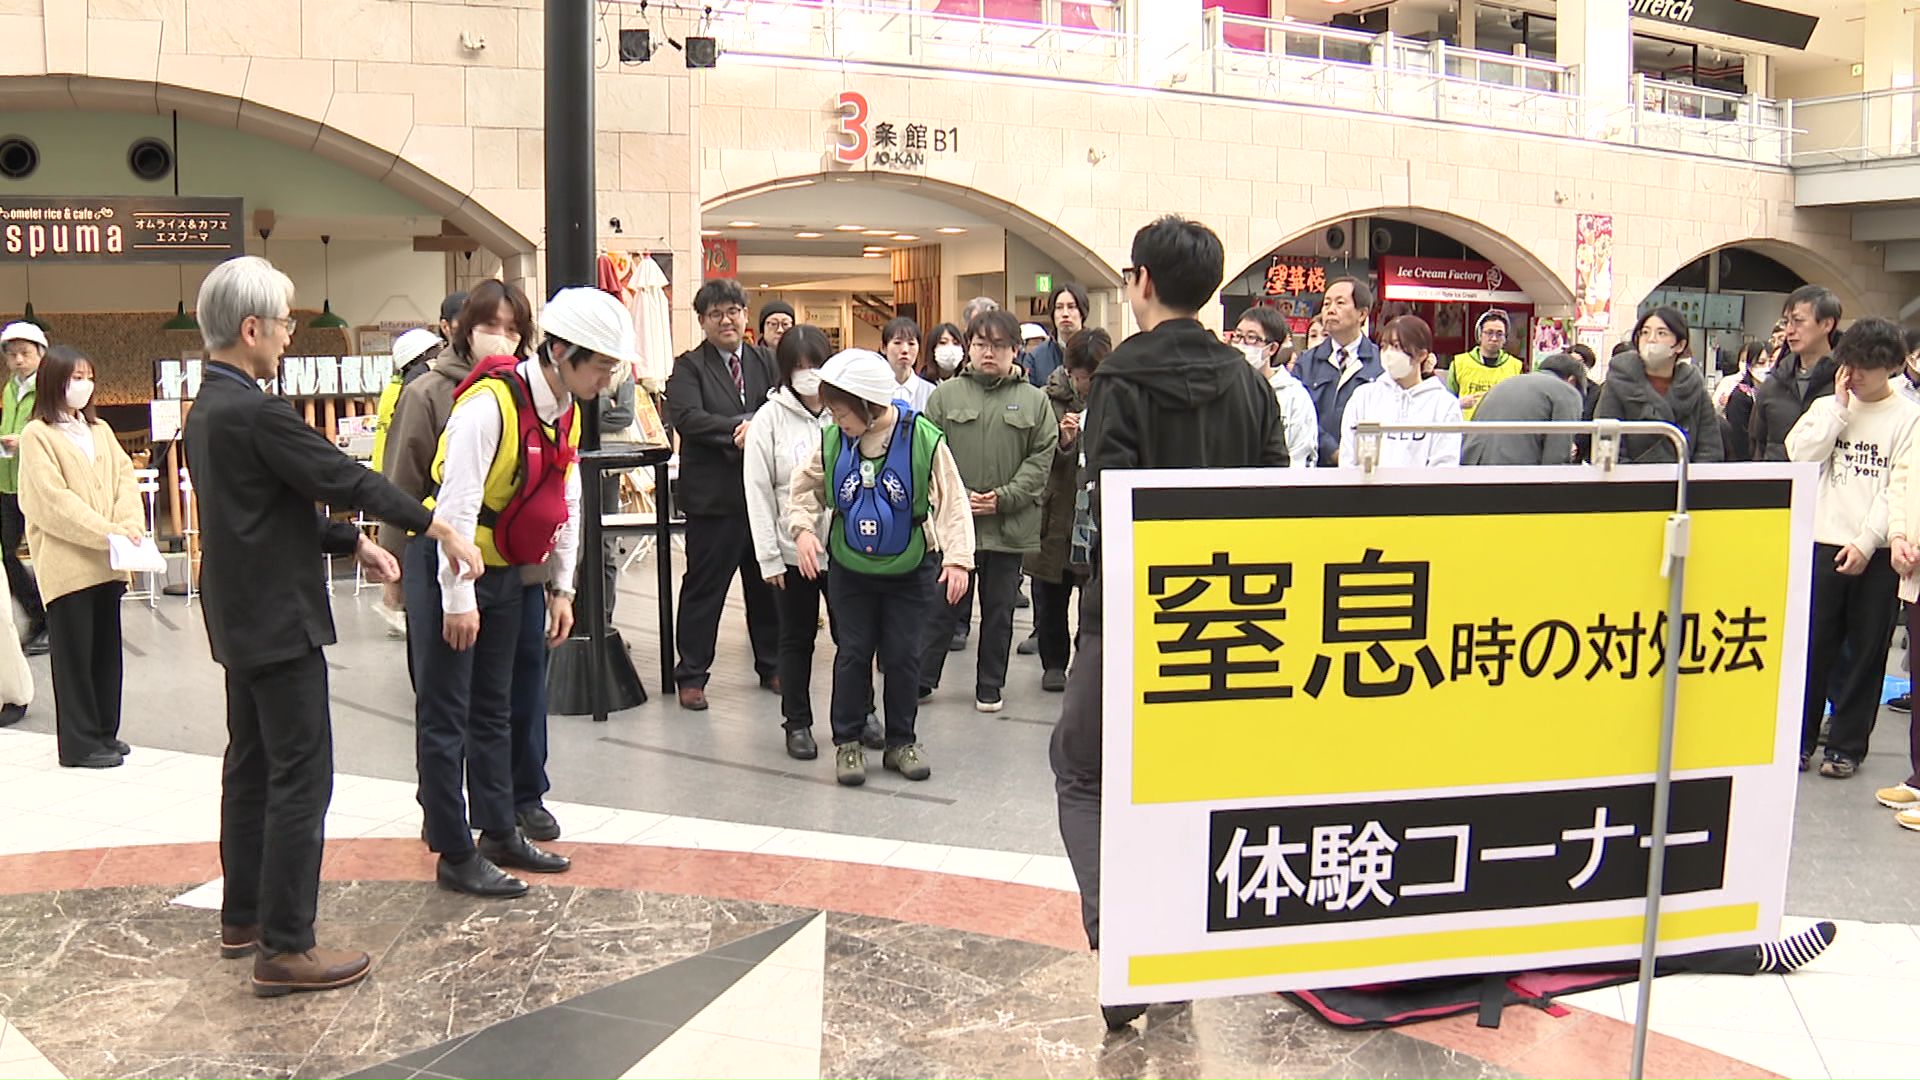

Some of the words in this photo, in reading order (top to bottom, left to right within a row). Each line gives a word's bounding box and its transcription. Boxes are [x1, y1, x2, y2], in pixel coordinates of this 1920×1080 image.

[10, 207, 42, 220] omelet
[44, 207, 62, 220] rice
[63, 207, 72, 220] &
[72, 207, 93, 220] cafe
[135, 218, 228, 230] オムライス&カフェ
[6, 224, 122, 257] spuma
[156, 231, 209, 242] エスプーマ
[1397, 265, 1413, 278] Ice
[1414, 266, 1447, 279] Cream
[1448, 270, 1484, 283] Factory
[1835, 437, 1851, 449] he
[1854, 441, 1879, 457] dog
[1844, 452, 1868, 465] will
[1854, 465, 1879, 478] you
[1143, 548, 1768, 704] 窒息時の対処法
[1215, 807, 1710, 919] 体験コーナー
